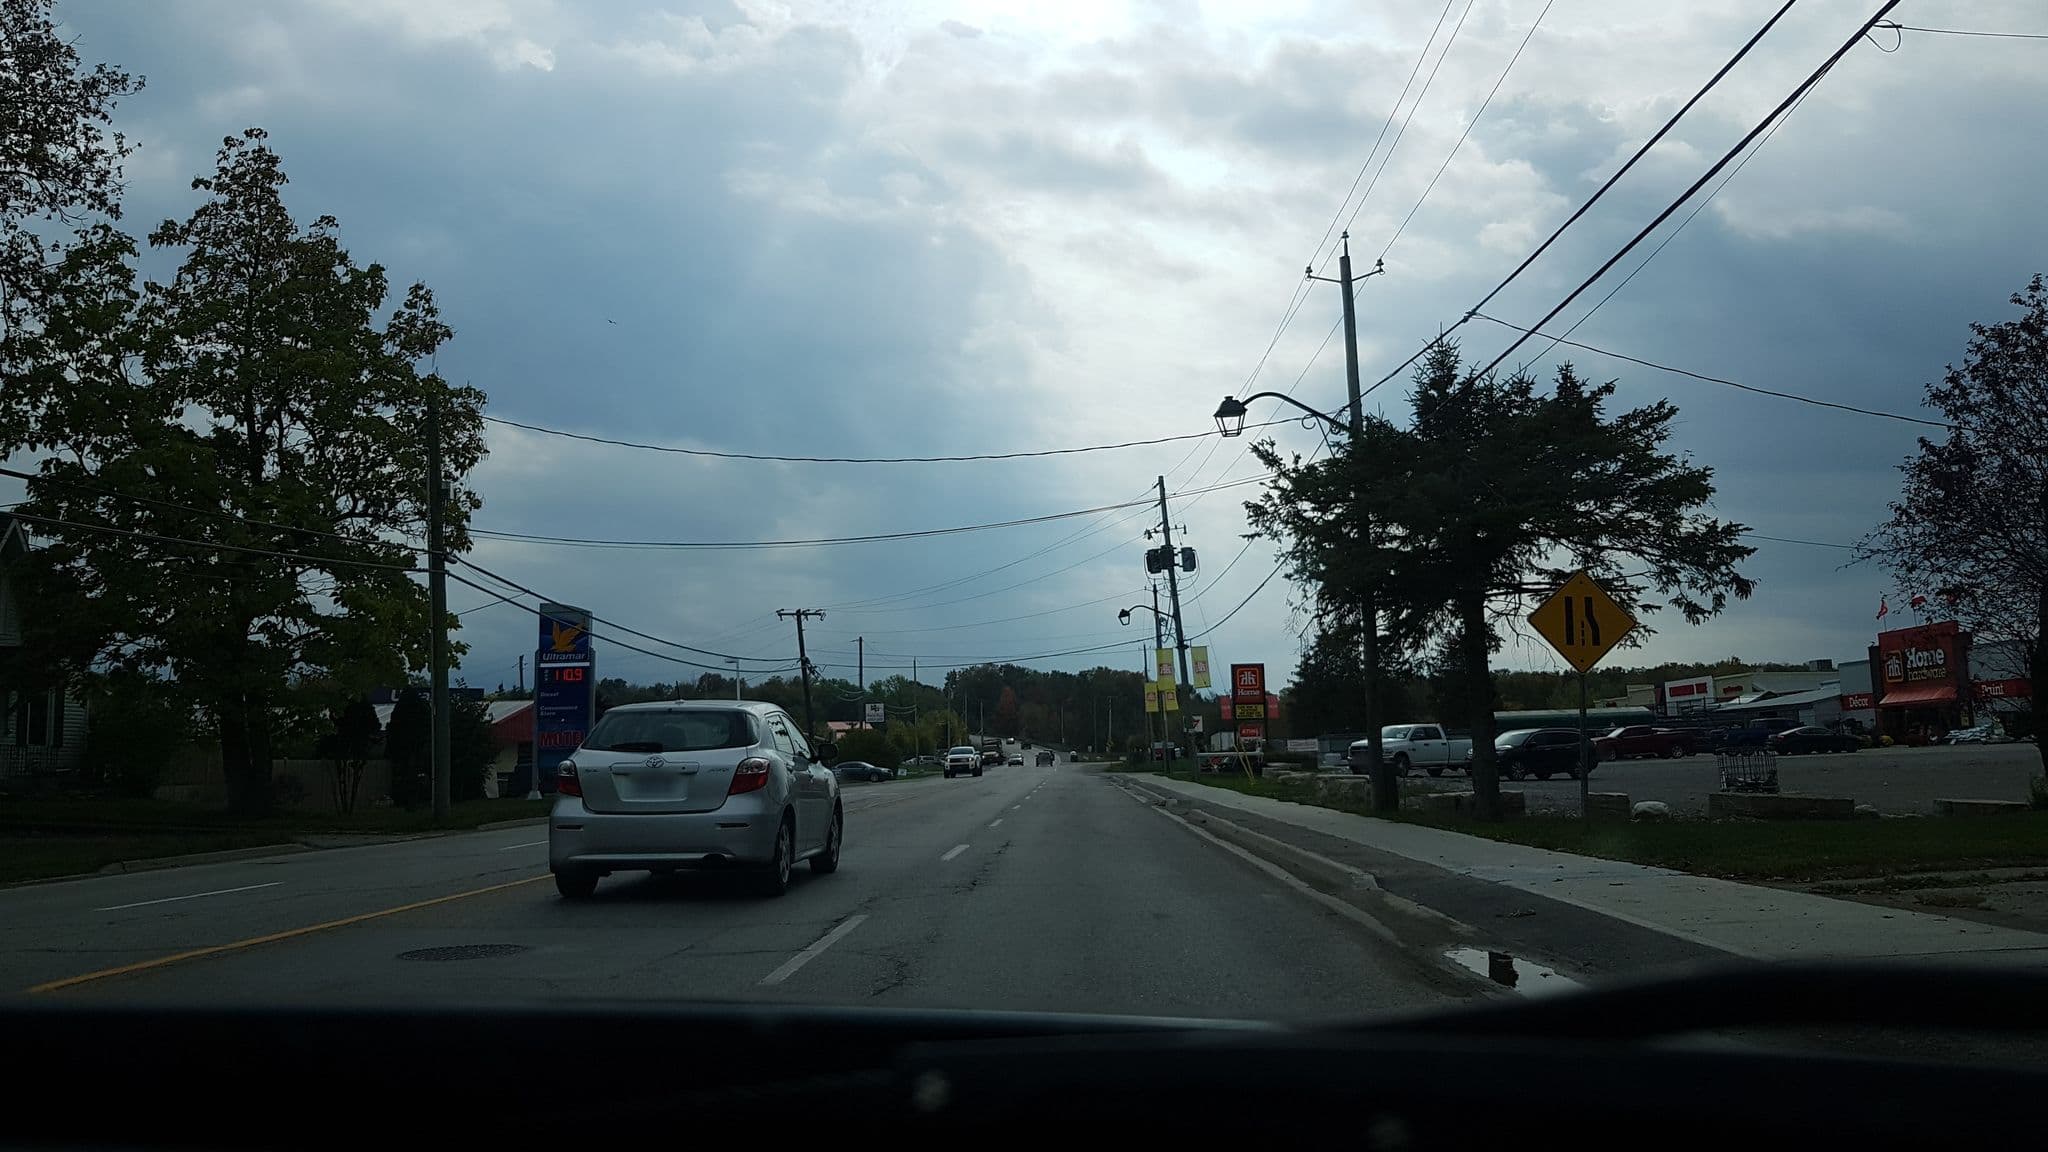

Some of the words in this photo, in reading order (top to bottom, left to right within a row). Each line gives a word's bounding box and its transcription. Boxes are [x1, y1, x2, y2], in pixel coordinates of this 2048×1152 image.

[543, 653, 587, 661] Ultramar
[1905, 647, 1945, 668] Home
[1907, 668, 1946, 681] hardware
[1237, 688, 1260, 696] Home
[1981, 684, 2005, 696] Paint
